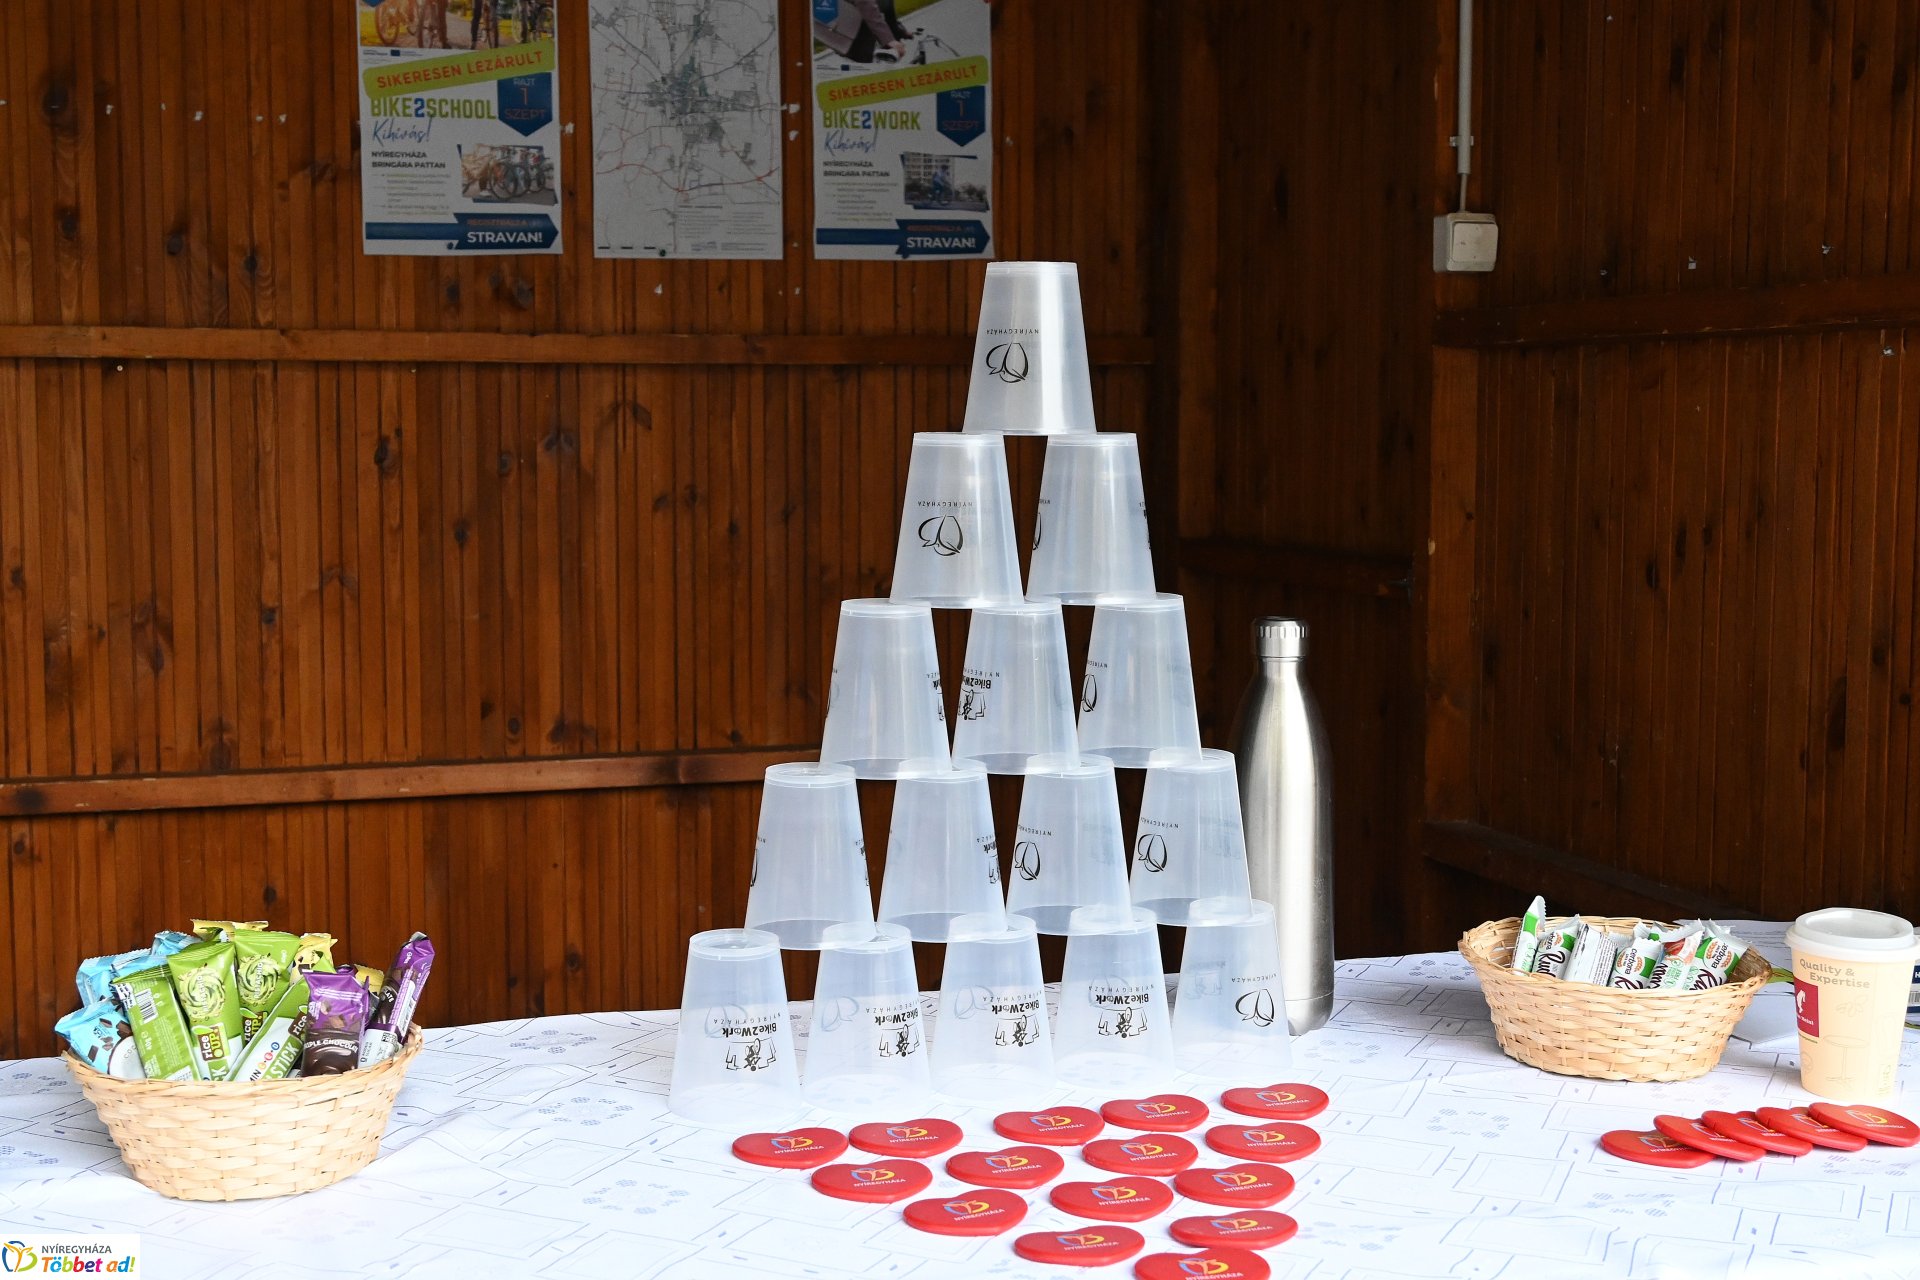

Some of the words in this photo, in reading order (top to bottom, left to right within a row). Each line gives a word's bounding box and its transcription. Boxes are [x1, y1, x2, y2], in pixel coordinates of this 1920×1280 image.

[377, 64, 462, 89] SIKERESEN
[466, 51, 543, 74] LEZÁRULT
[513, 77, 536, 87] RAJT
[829, 78, 905, 101] SIKERESEN
[910, 65, 978, 87] LEZÁRULT
[520, 87, 529, 106] 1
[371, 97, 497, 120] BIKE2SCHOOL
[504, 109, 547, 121] SZEPT
[958, 101, 965, 117] 1
[823, 109, 921, 131] BIKE2WORK
[372, 117, 433, 146] Kihívás!
[371, 150, 427, 159] NYÍREGYHÁZA
[372, 160, 413, 169] BRINGÁRA
[414, 161, 446, 169] PATTAN
[823, 160, 874, 169] NYÍREGYHÁZA
[862, 170, 891, 178] PATTAN
[467, 231, 543, 244] STRAVAN!
[907, 237, 977, 249] STRAVAN!
[986, 328, 1040, 336] NYÍREGYHÁZA
[917, 500, 973, 508] NYÍREGYHÁZA
[963, 676, 992, 690] Bike2W
[1623, 948, 1638, 976] cerbona
[1799, 958, 1842, 977] Quality
[1845, 968, 1855, 977] &
[254, 962, 264, 999] PISTACHIO
[1809, 971, 1871, 989] Expertise
[244, 1019, 252, 1042] rice
[294, 1015, 307, 1036] rice
[201, 1035, 214, 1059] rice
[276, 1041, 300, 1078] STICK
